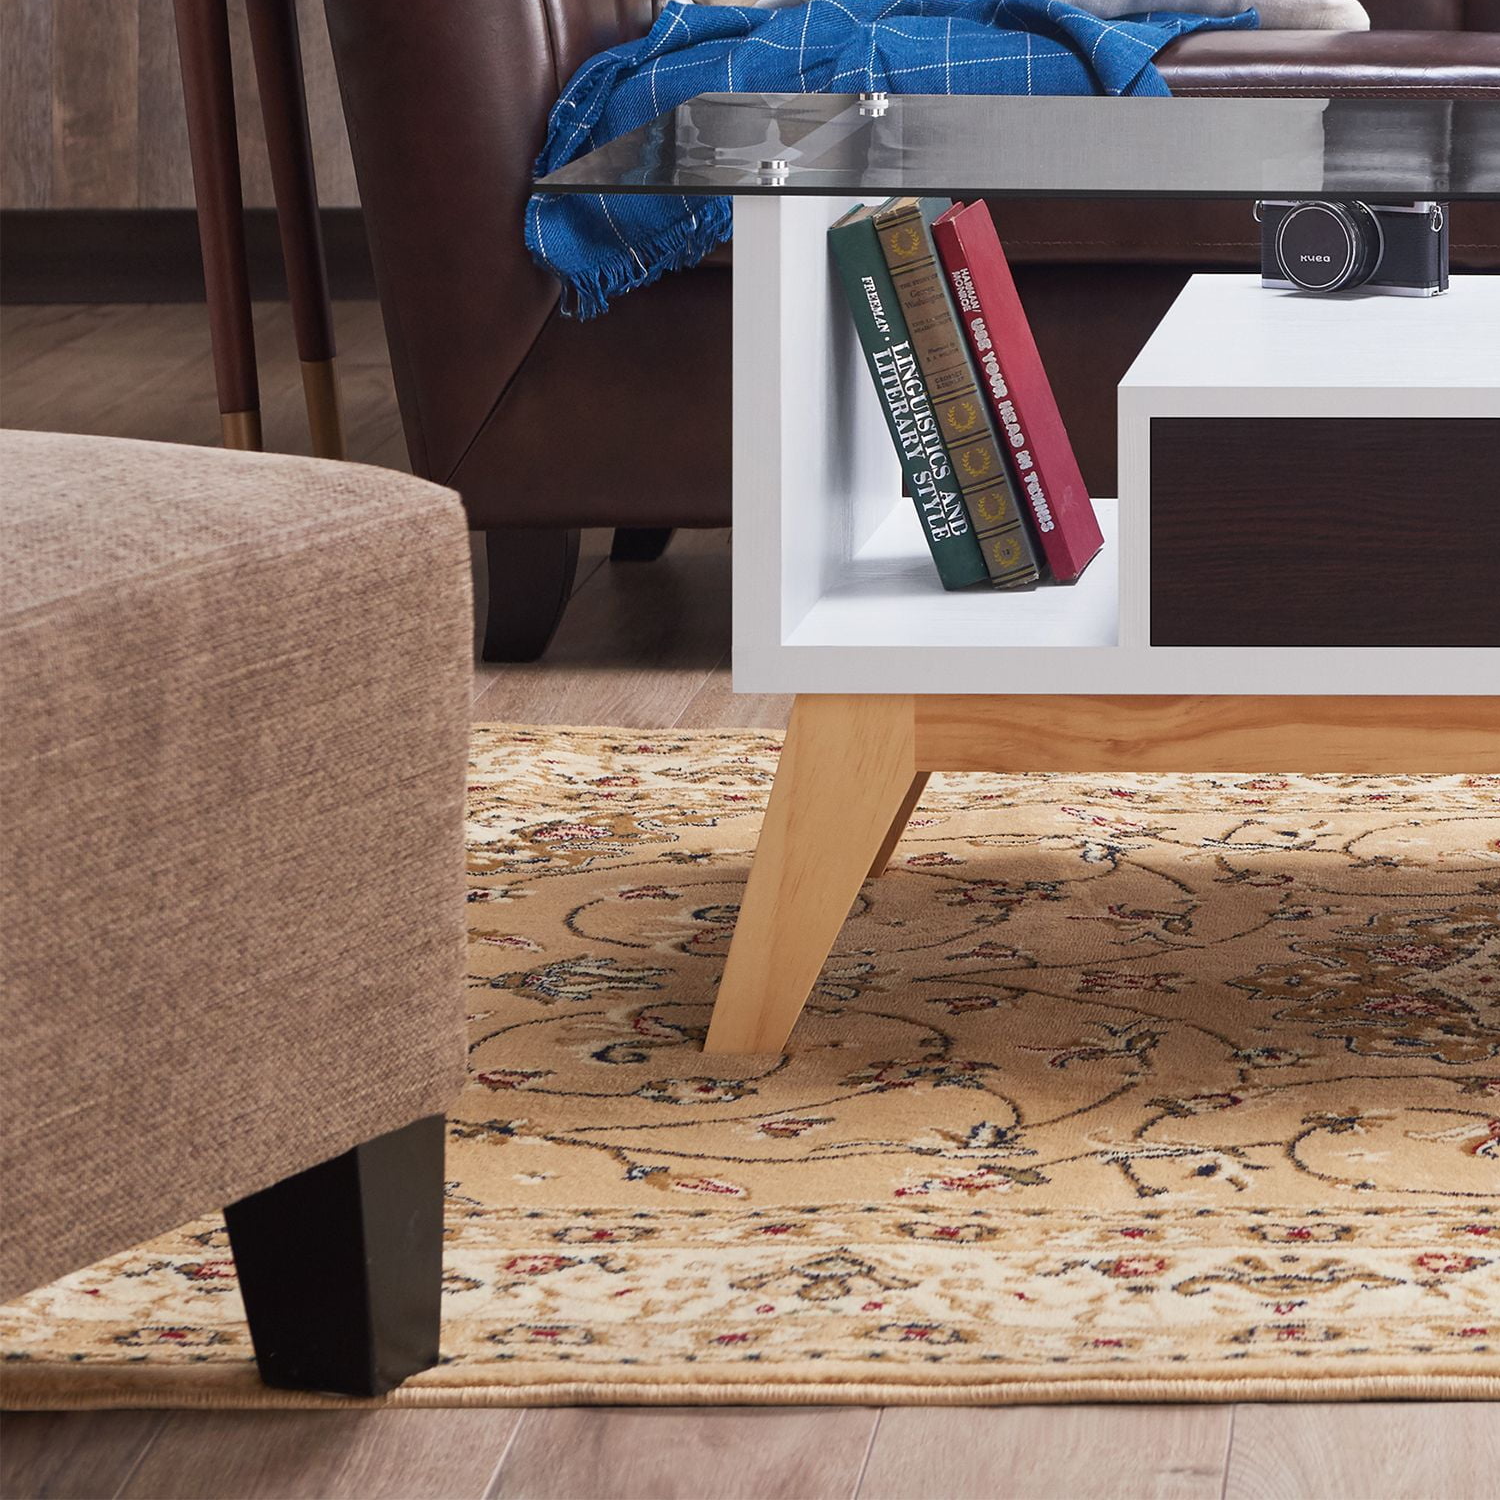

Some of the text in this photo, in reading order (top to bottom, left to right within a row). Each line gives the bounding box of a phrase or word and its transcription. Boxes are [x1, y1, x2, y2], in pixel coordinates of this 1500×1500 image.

[861, 275, 891, 335] FREEMAN
[952, 271, 972, 312] MONROE
[873, 348, 951, 542] LITERARY STYLE
[891, 340, 951, 480] LINGUISTICS
[940, 490, 969, 537] AND
[981, 351, 1008, 399] YOUR
[998, 400, 1025, 448] HEAD
[1015, 450, 1033, 470] IN
[1024, 471, 1055, 533] TENNIS
